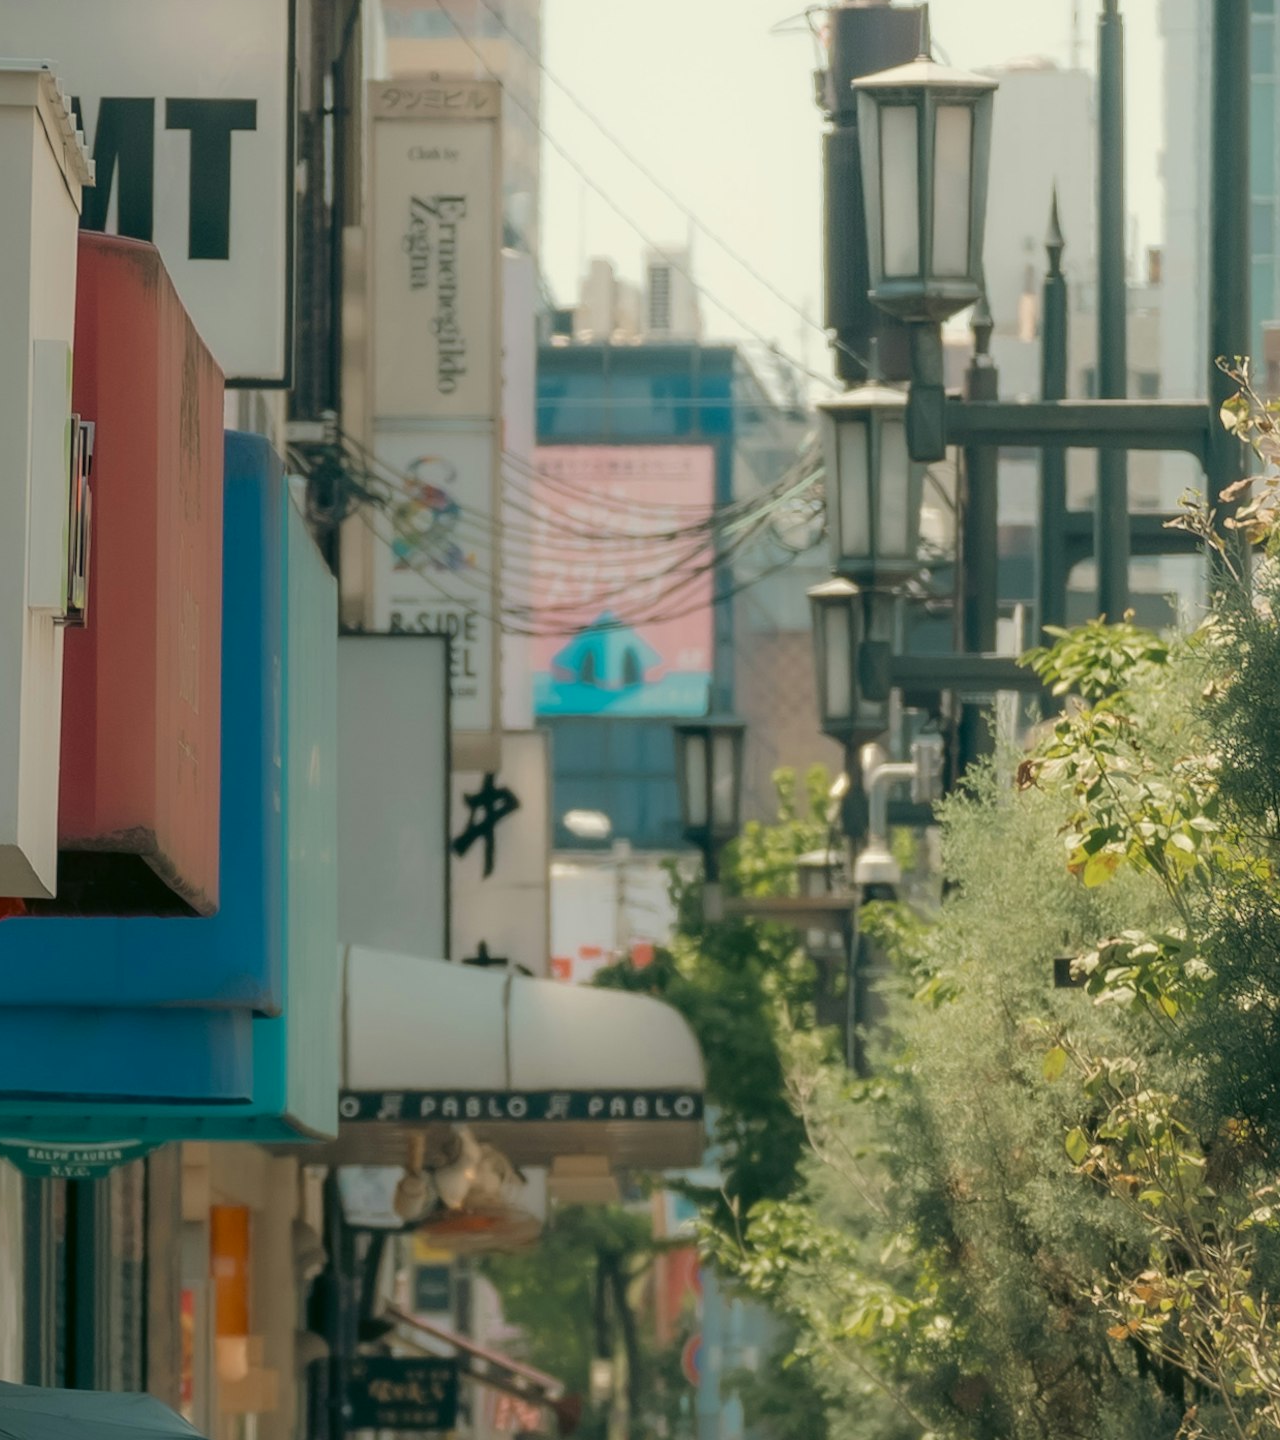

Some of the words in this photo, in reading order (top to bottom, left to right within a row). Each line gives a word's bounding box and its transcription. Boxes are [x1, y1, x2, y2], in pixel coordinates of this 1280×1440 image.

[401, 195, 439, 291] Zegna
[430, 195, 466, 394] Ermenegildo
[420, 1096, 527, 1118] PABLO
[588, 1095, 695, 1118] PABLO
[28, 1148, 69, 1160] RALPH
[74, 1150, 121, 1161] LAUREN
